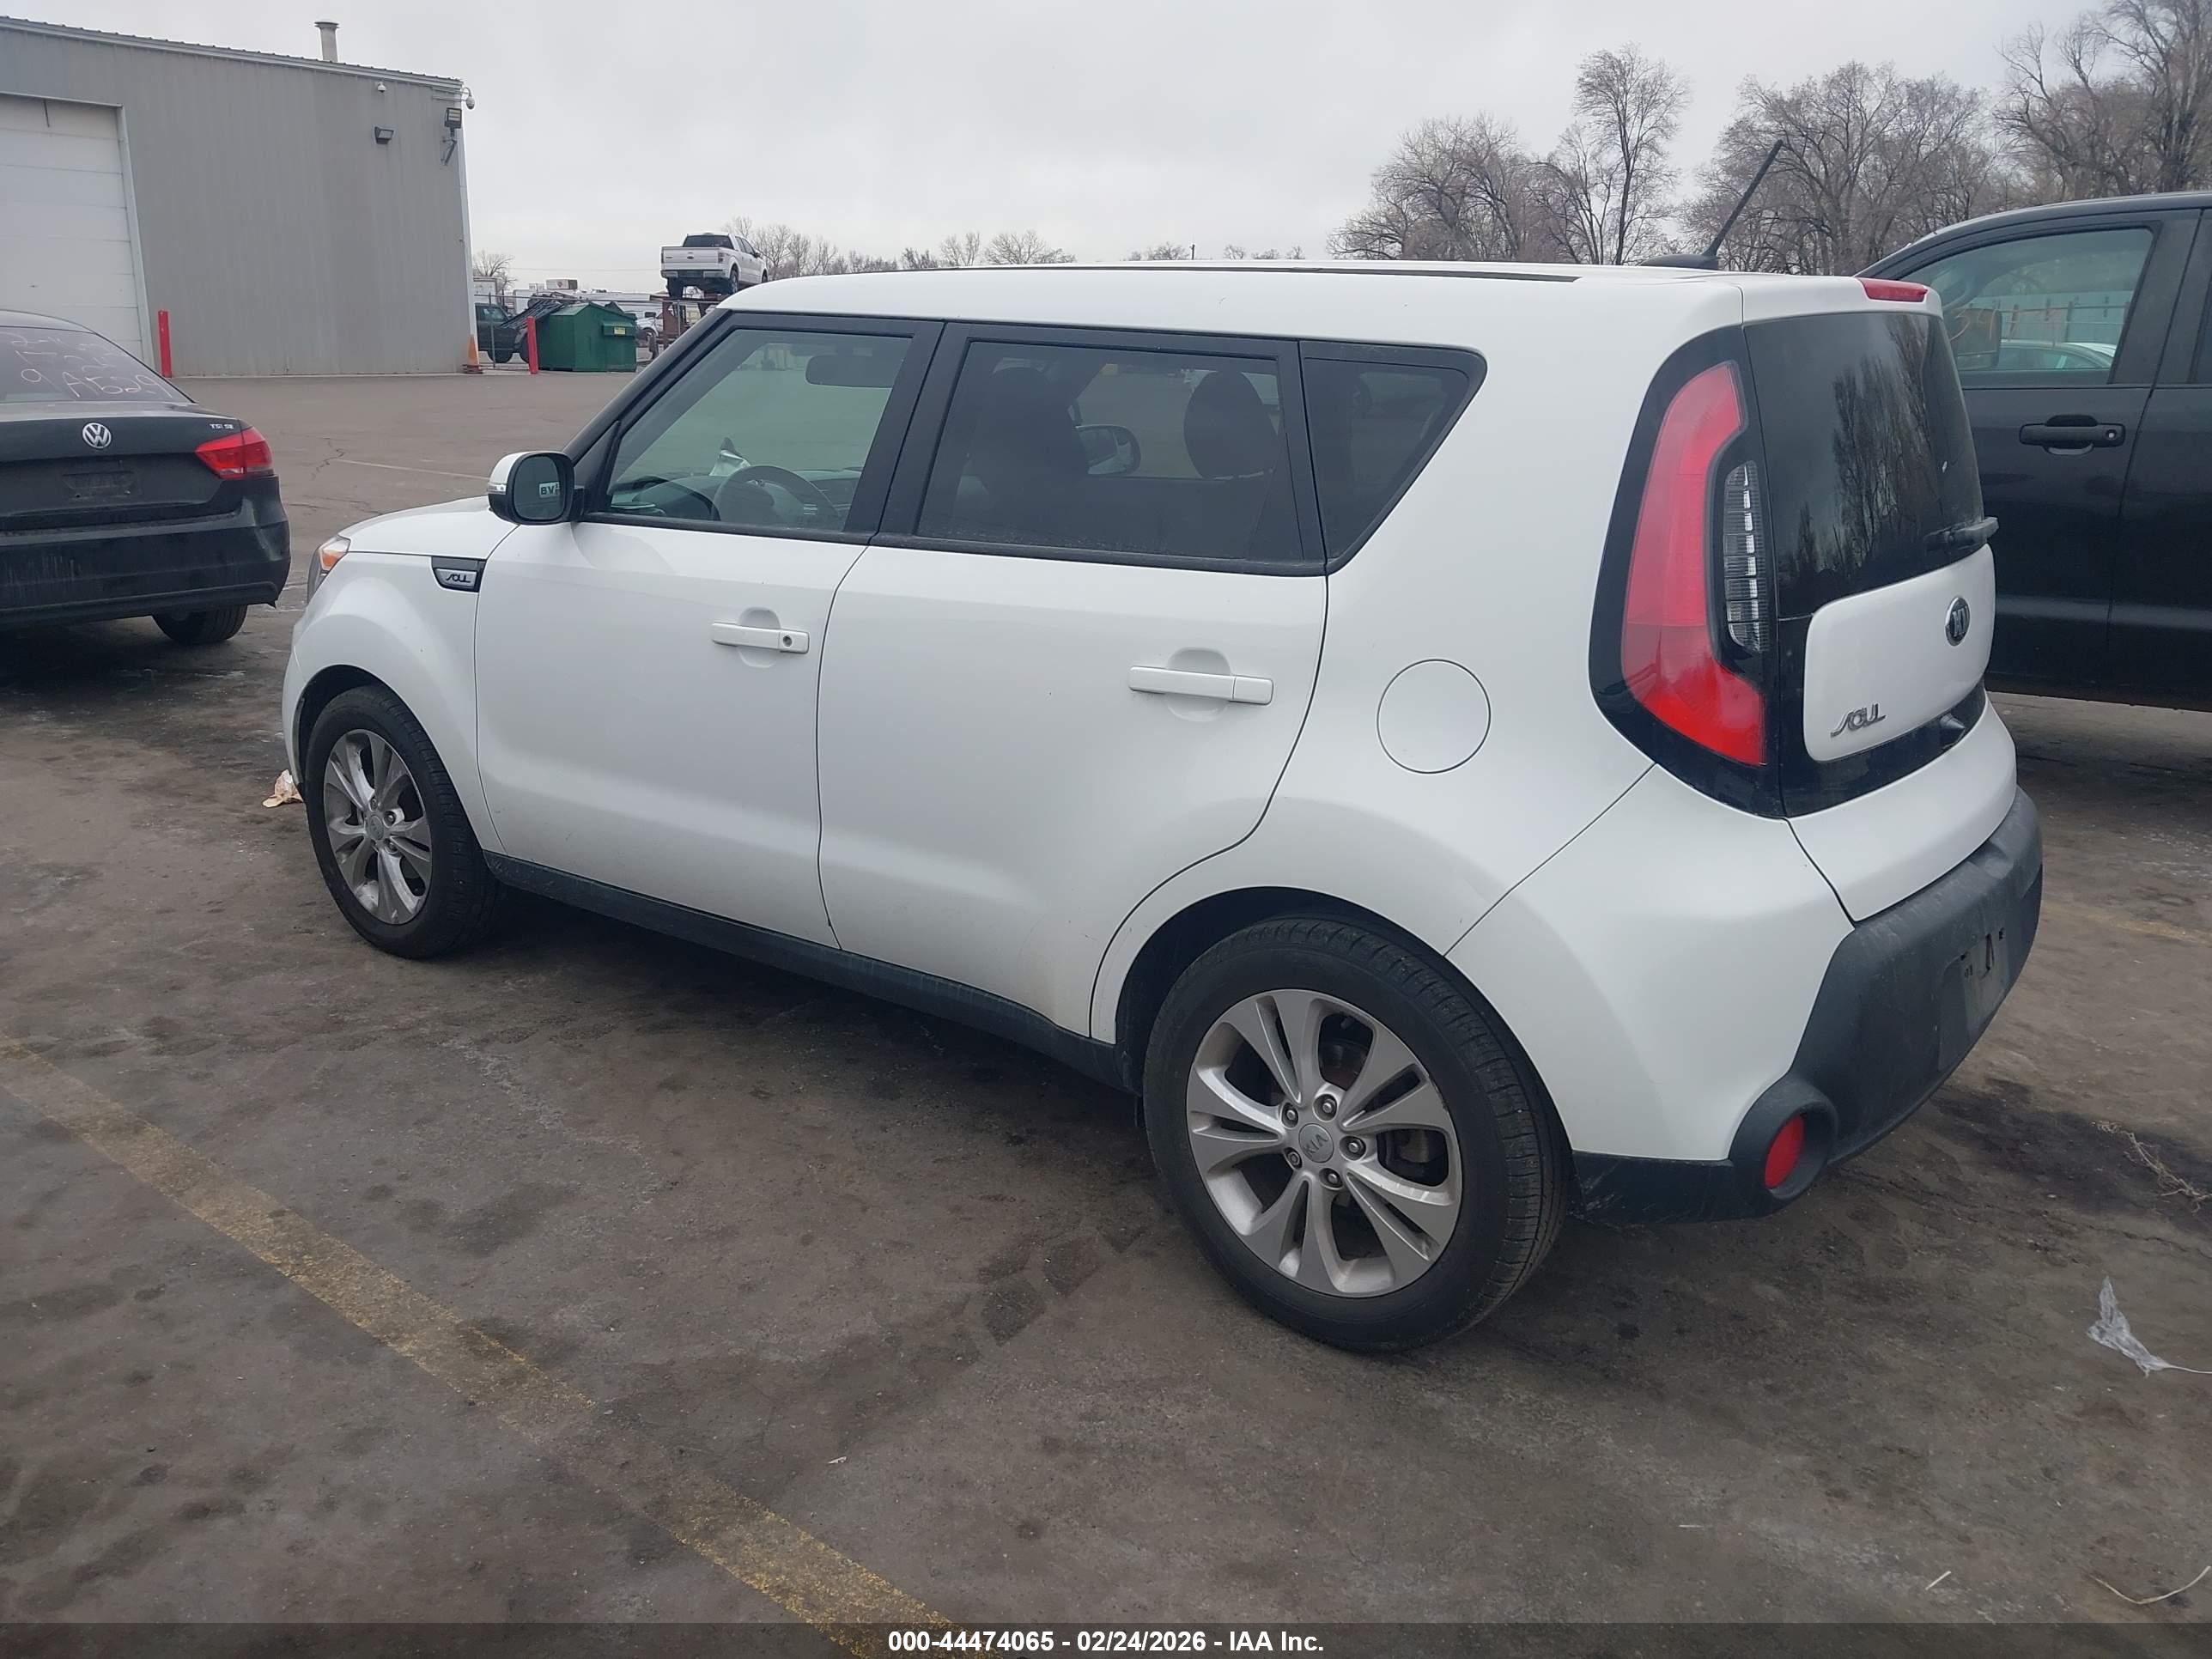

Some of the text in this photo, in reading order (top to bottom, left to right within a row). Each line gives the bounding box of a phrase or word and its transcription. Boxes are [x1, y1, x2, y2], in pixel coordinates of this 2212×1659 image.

[82, 422, 112, 449] VW
[1830, 703, 1886, 738] SOUL
[1304, 1133, 1328, 1158] KIA
